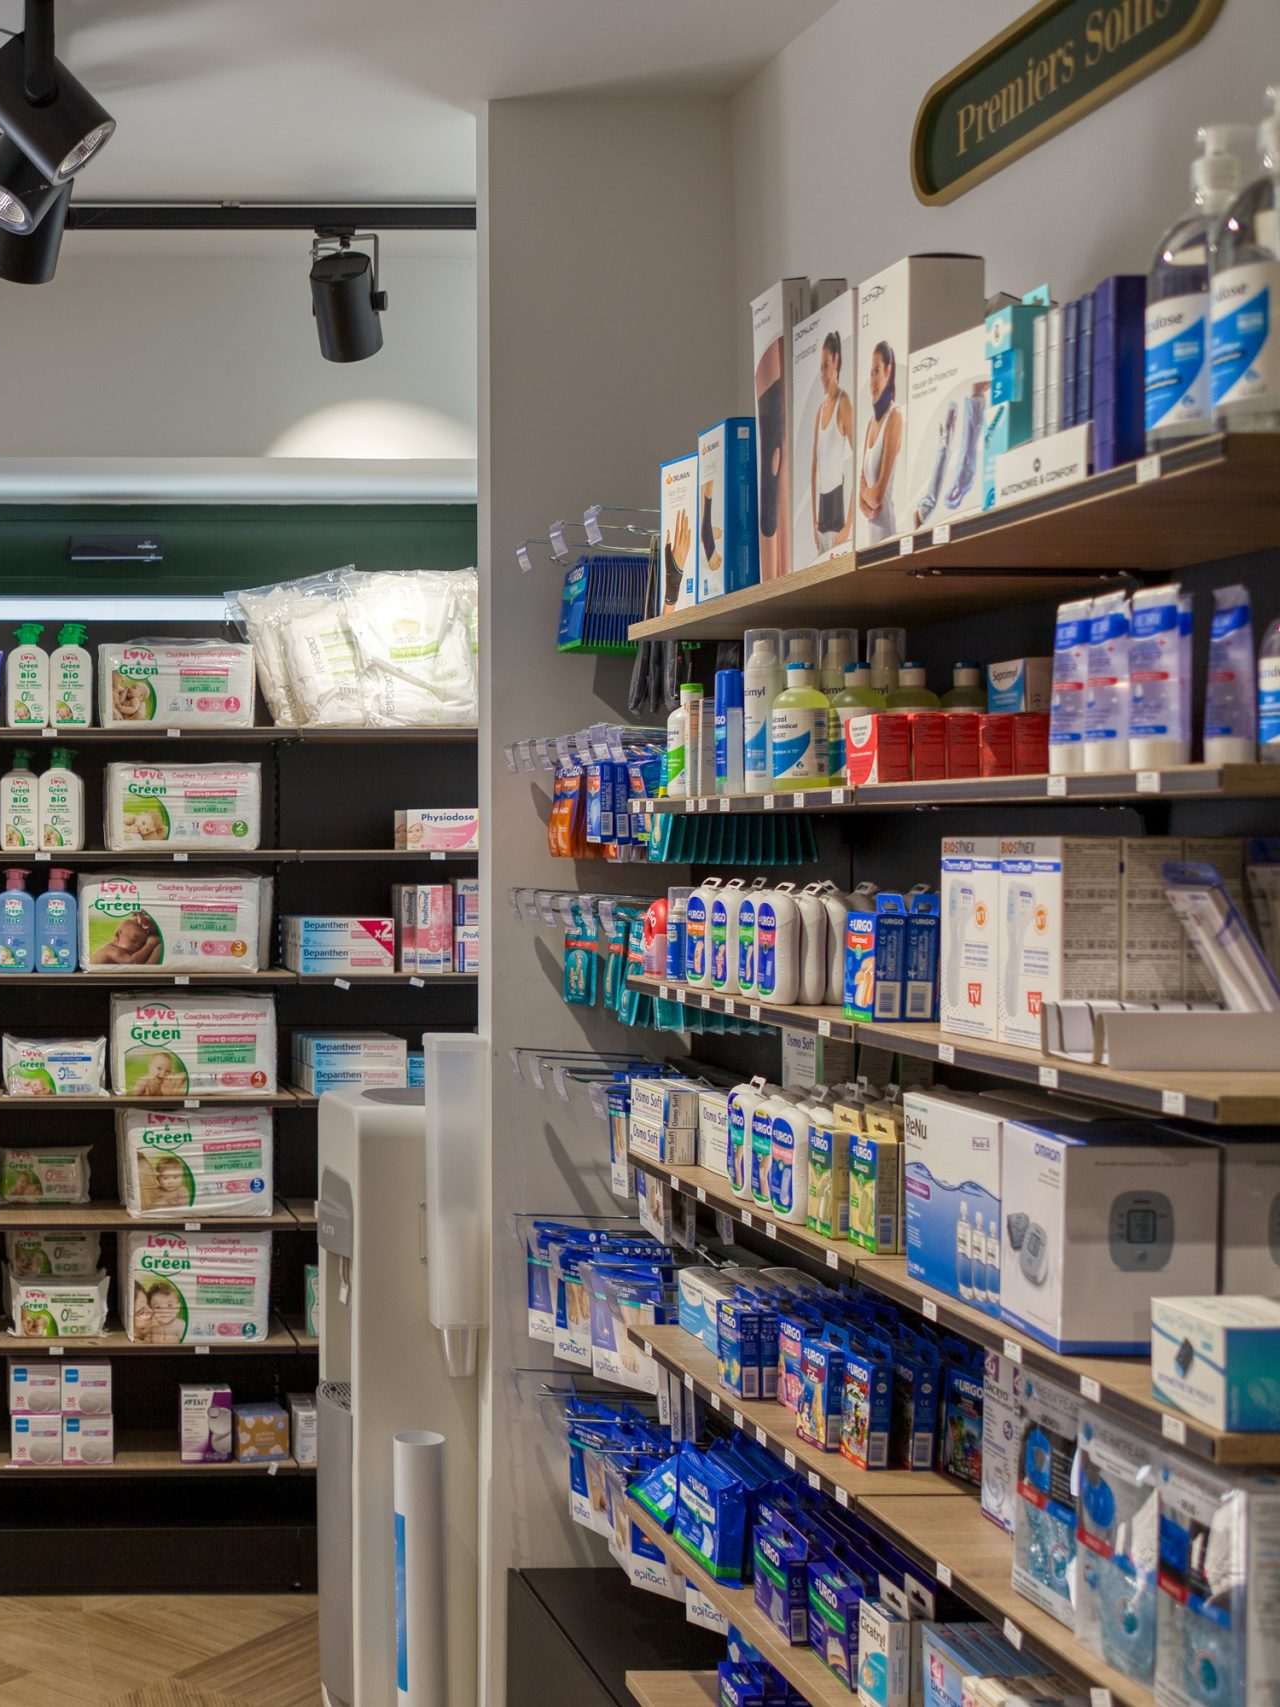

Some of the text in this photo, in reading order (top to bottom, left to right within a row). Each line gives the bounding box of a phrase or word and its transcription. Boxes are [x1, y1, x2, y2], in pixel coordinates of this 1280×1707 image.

[956, 40, 1074, 157] Premiers
[794, 318, 821, 342] DONJOY
[1000, 472, 1039, 498] AUTONOMIE
[123, 648, 155, 660] Love
[119, 665, 159, 676] Green
[992, 667, 1018, 683] Septimyl
[230, 697, 235, 706] 1
[132, 768, 164, 780] Love
[128, 784, 167, 795] Green
[421, 812, 475, 822] Physiodose
[236, 821, 245, 831] 2
[943, 840, 975, 854] BIOSYNEX
[1001, 840, 1035, 855] BIOSYNEX
[100, 880, 138, 894] Love
[94, 900, 142, 911] Green
[422, 891, 431, 926] ProRhinel
[690, 909, 705, 920] URGO
[714, 912, 726, 923] URGO
[742, 912, 754, 923] URGO
[883, 917, 905, 926] URGO
[914, 917, 936, 926] URGO
[303, 920, 349, 931] Bepanthen
[762, 916, 776, 928] URGO
[853, 919, 873, 932] URGO
[234, 941, 242, 950] 3
[303, 948, 349, 958] Bepanthen
[136, 1007, 176, 1020] Love
[184, 1012, 209, 1020] Couches
[130, 1026, 181, 1040] Green
[315, 1042, 398, 1054] Bepanthen Pommade
[786, 1033, 816, 1052] Osmo Soft
[207, 1056, 246, 1064] NATURELLE
[254, 1071, 263, 1082] 4
[316, 1070, 399, 1081] Bepanthen Pommade
[634, 1088, 663, 1111] Osmo Soft
[671, 1093, 680, 1128] Osmo Soft
[703, 1104, 717, 1125] Osmo
[147, 1113, 187, 1126] Love
[632, 1123, 660, 1146] Osmo Soft
[755, 1122, 771, 1136] URGO
[904, 1115, 928, 1141] ReNu
[143, 1131, 193, 1145] Green
[776, 1130, 793, 1145] URGO
[813, 1136, 829, 1151] URGO
[856, 1146, 873, 1161] URGO
[1033, 1142, 1062, 1164] OMRON
[253, 1179, 261, 1187] 5
[147, 1236, 187, 1250] Love
[211, 1237, 240, 1245] Couches
[141, 1256, 191, 1270] Green
[23, 1302, 48, 1310] Green
[206, 1298, 245, 1306] NATURELLE
[245, 1323, 252, 1332] 6
[531, 1320, 555, 1335] epitact
[722, 1313, 736, 1329] URGO
[783, 1323, 801, 1342] URGO
[558, 1340, 587, 1357] epitact
[806, 1348, 826, 1367] URGO
[595, 1358, 619, 1374] epitact
[850, 1362, 869, 1382] URGO
[958, 1379, 984, 1401] URGO
[984, 1380, 1010, 1402] DACRYO
[183, 1398, 209, 1406] AVENT
[763, 1537, 780, 1568] URGO
[633, 1568, 669, 1588] epitact
[818, 1581, 839, 1609] URGO
[691, 1603, 725, 1624] epitact
[860, 1614, 887, 1653] Cicatryl
